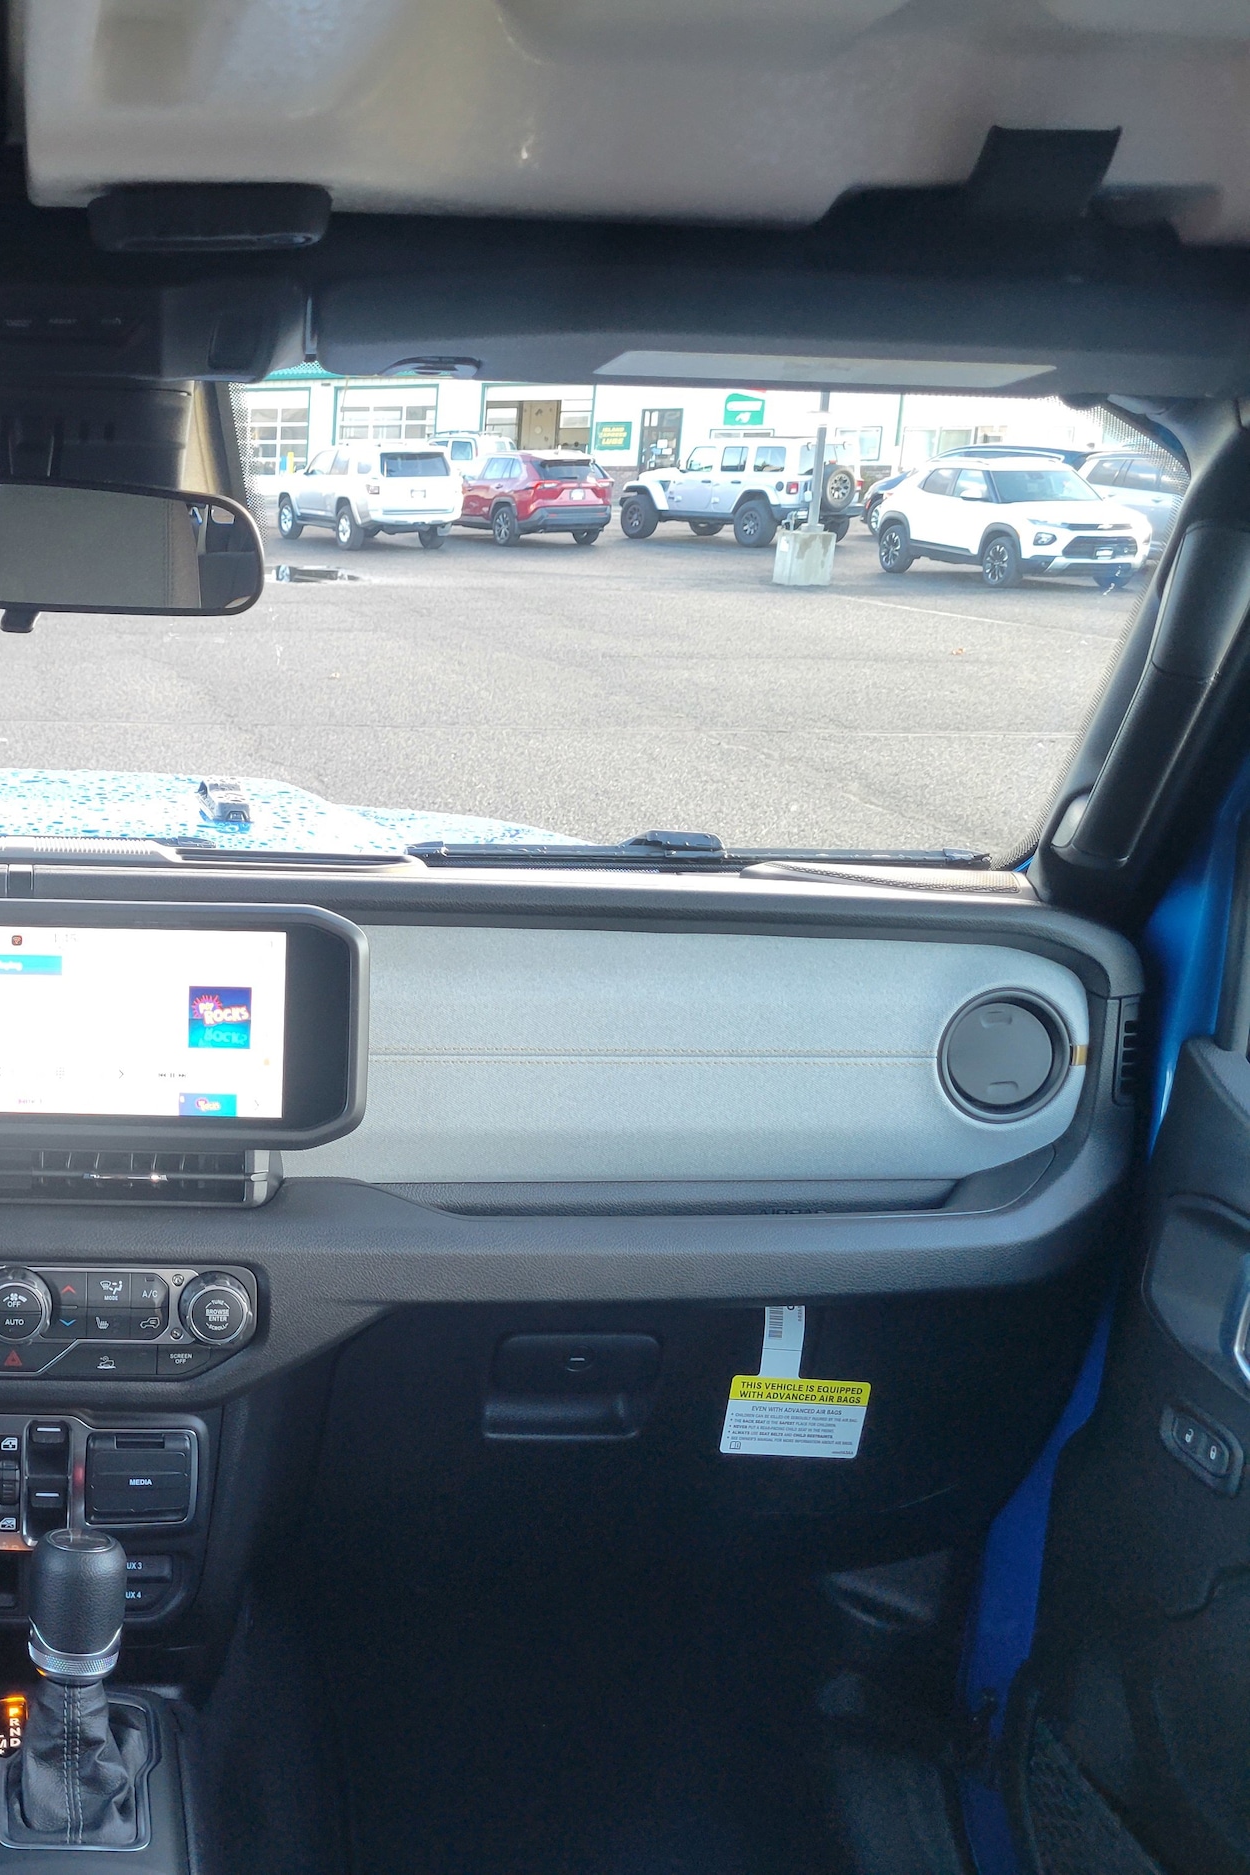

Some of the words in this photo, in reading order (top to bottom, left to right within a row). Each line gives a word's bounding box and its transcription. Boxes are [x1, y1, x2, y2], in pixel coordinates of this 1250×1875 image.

[204, 1006, 248, 1025] ROCKS
[142, 1290, 158, 1298] A/C
[741, 1381, 762, 1389] THIS
[765, 1383, 803, 1391] VEHICLE
[817, 1386, 862, 1394] EQUIPPED
[740, 1390, 763, 1398] WITH
[766, 1392, 816, 1401] ADVANCED
[129, 1478, 152, 1486] MEDIA
[126, 1562, 137, 1570] UX
[138, 1562, 142, 1570] 3
[125, 1591, 136, 1599] UX
[9, 1708, 19, 1717] P
[10, 1718, 20, 1726] R
[10, 1727, 21, 1736] N
[10, 1738, 21, 1747] D
